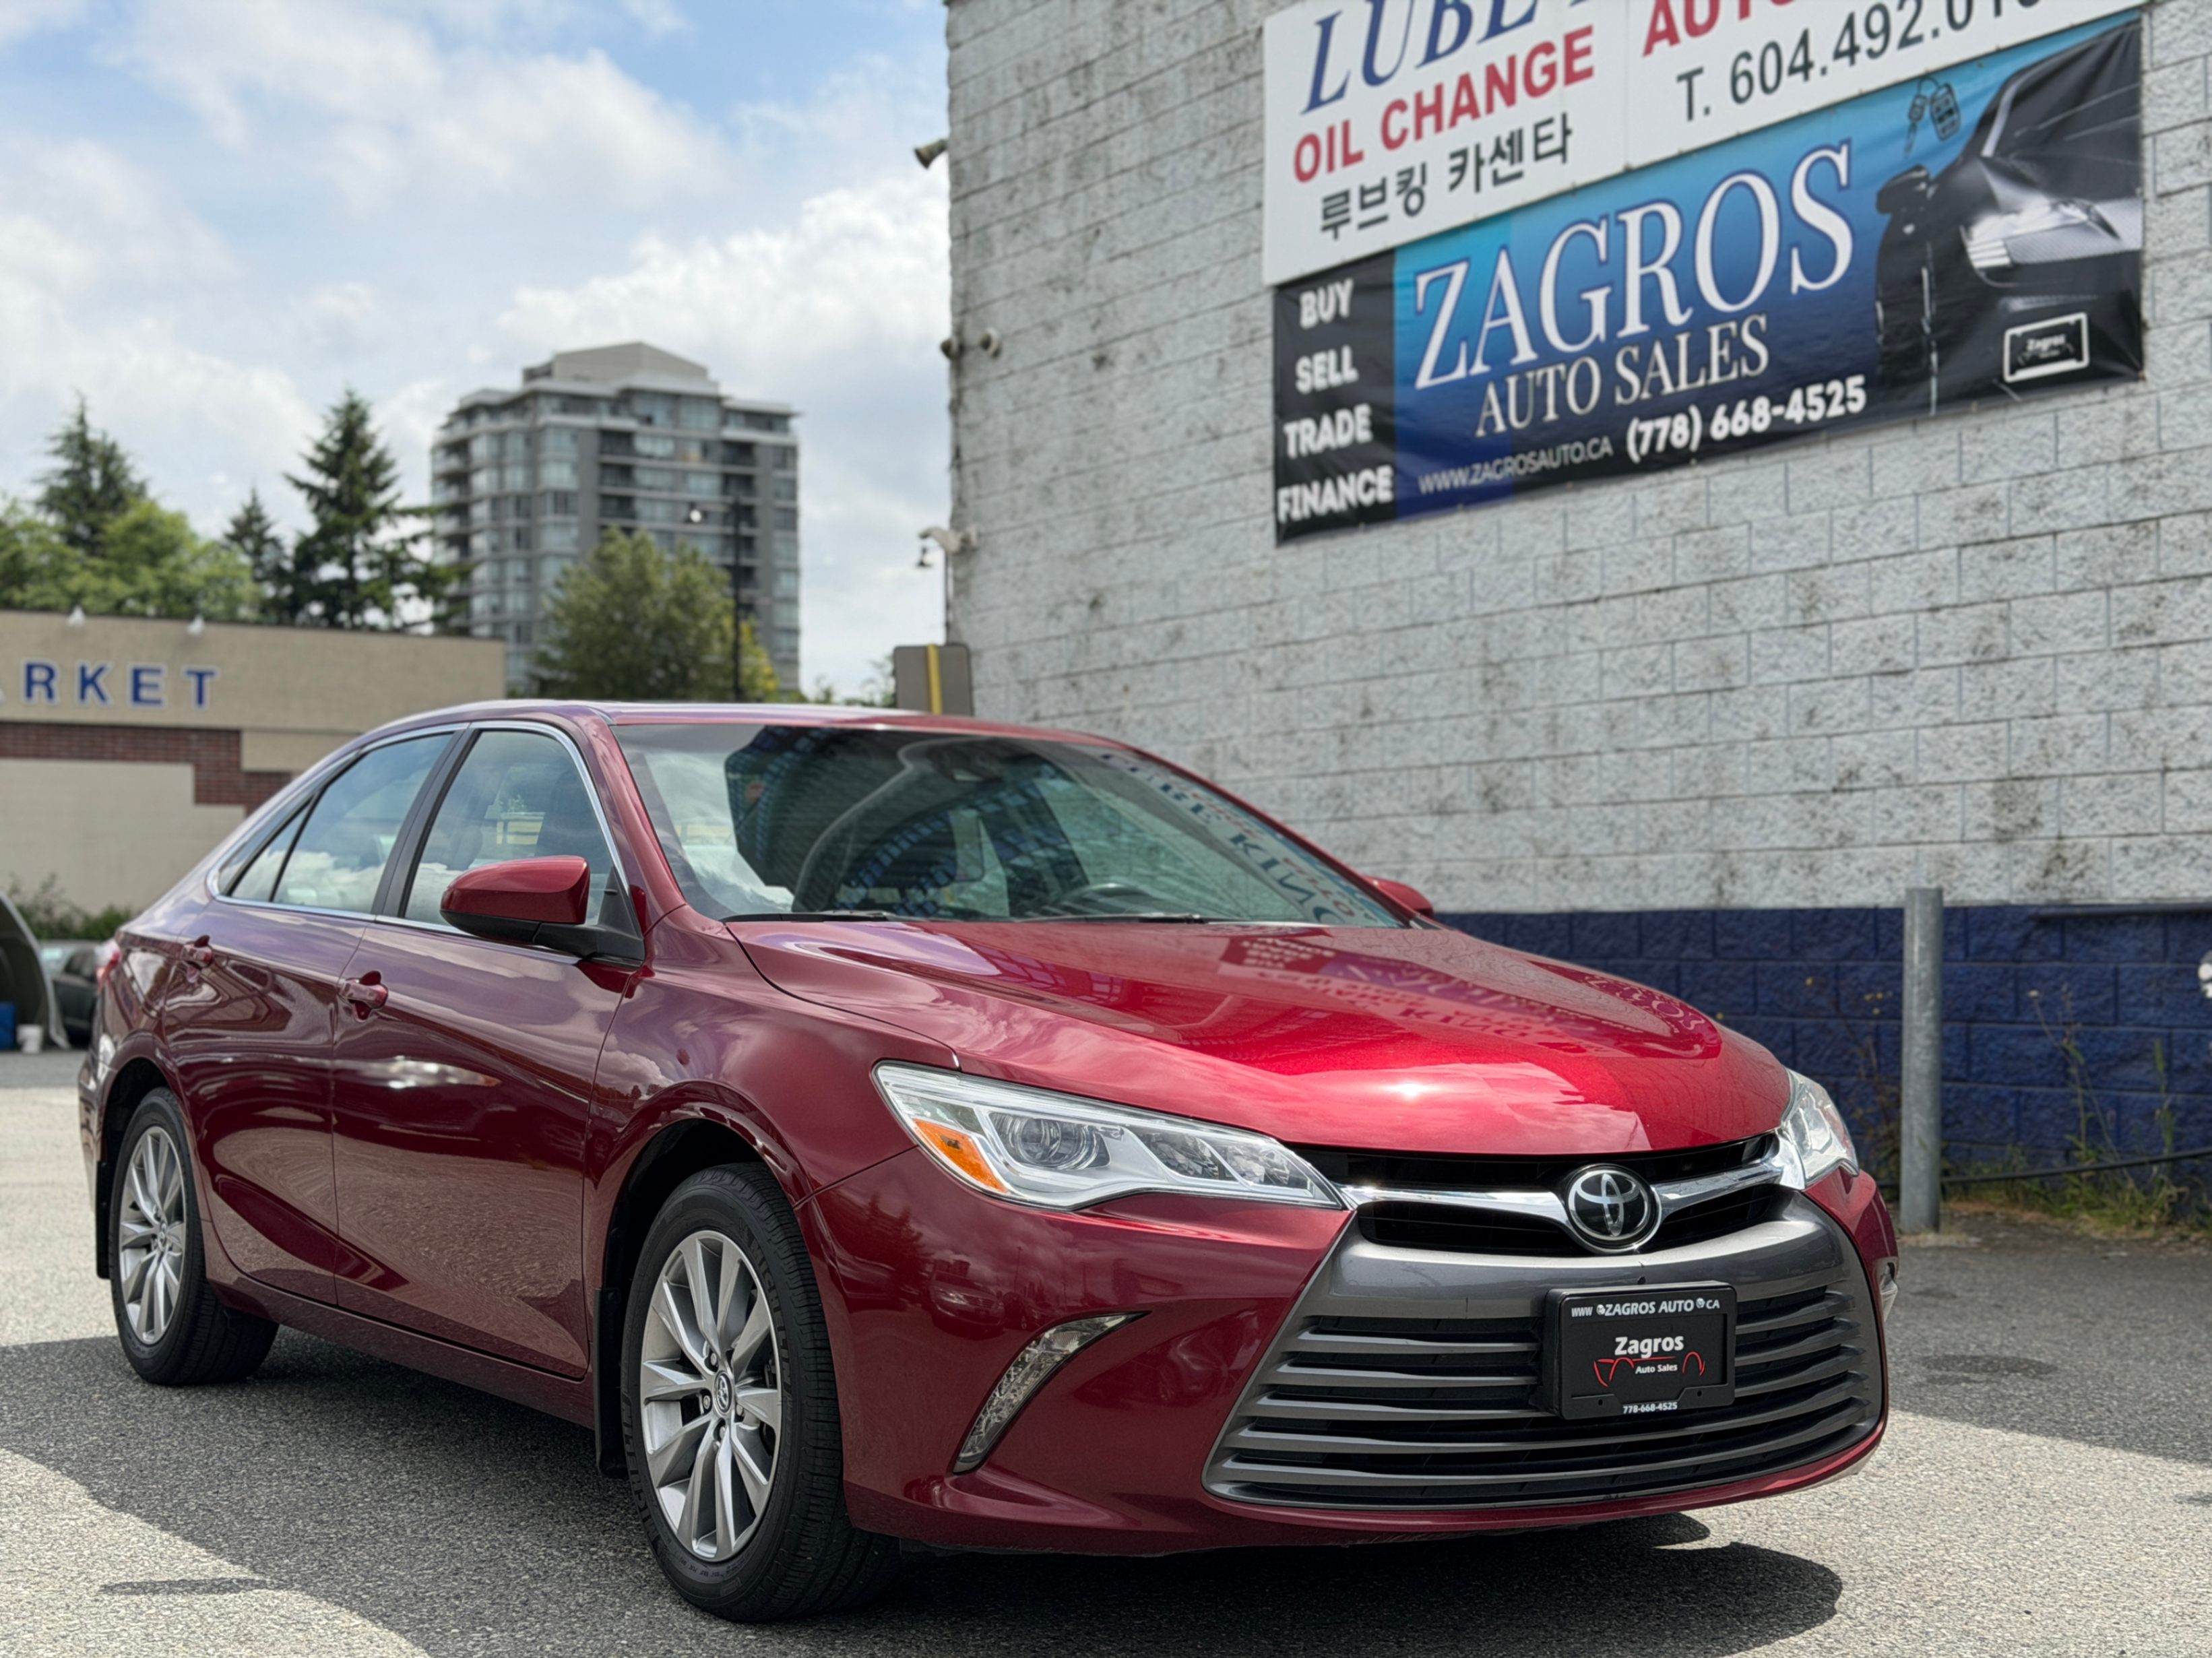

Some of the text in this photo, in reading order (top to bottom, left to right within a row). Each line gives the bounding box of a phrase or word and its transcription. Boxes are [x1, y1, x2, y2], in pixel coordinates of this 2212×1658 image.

[1643, 0, 1796, 57] AU
[1676, 0, 2042, 122] T. 604.492.0
[1294, 24, 1595, 183] OIL CHANGE
[1321, 113, 1573, 241] 루브킹 카센타
[1414, 138, 1854, 390] ZAGROS
[1300, 278, 1354, 329] BUY
[1295, 344, 1360, 395] SELL
[1475, 313, 1769, 438] AUTO SALES
[1283, 403, 1373, 459] TRADE
[1626, 406, 1703, 463] (778)
[1709, 375, 1867, 441] 668-4525
[1277, 464, 1394, 523] FINANCE
[0, 659, 217, 708] RKET
[749, 1236, 792, 1389] MICHELIN
[1604, 1301, 1656, 1316] ZAGROS
[1658, 1299, 1695, 1313] AUTO
[1705, 1299, 1720, 1310] CA
[1614, 1335, 1684, 1359] Zagros
[1635, 1363, 1678, 1375] Auto Sales
[1622, 1401, 1678, 1414] 778-668-4525
[621, 1399, 662, 1543] MICHELIN
